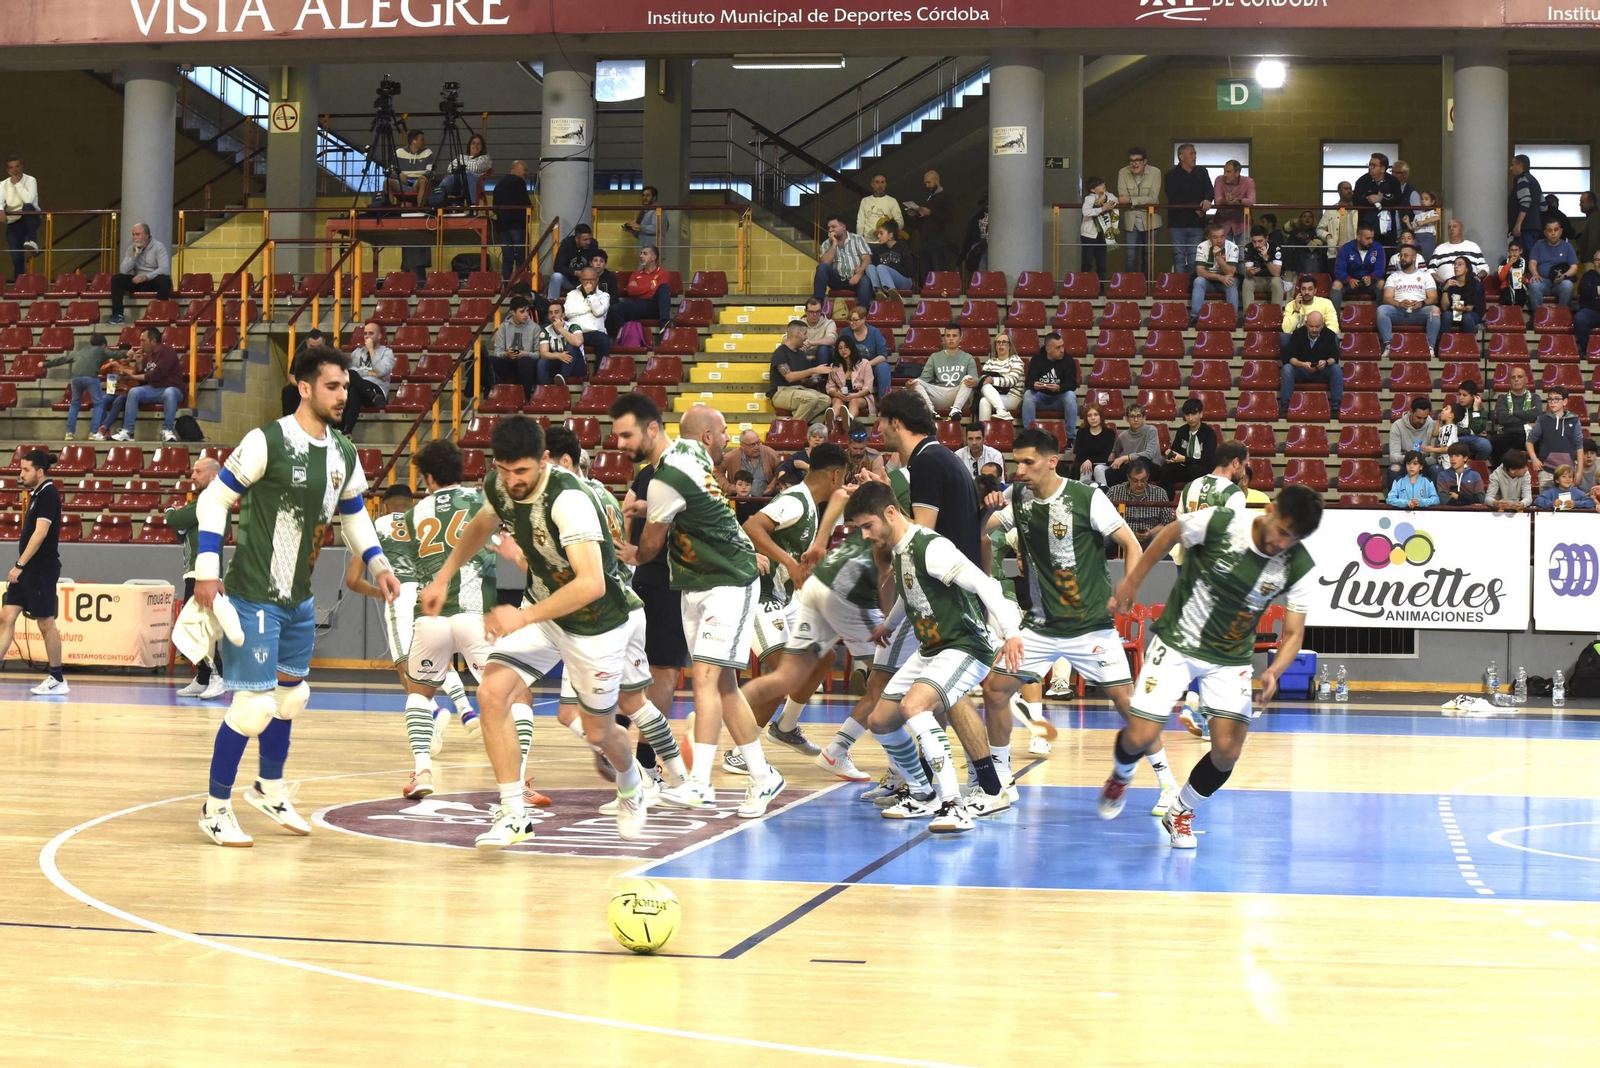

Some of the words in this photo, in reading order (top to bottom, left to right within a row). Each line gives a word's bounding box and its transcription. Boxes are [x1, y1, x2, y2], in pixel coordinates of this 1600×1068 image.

[130, 0, 276, 36] VISTA
[292, 0, 510, 31] ALEGRE
[647, 10, 716, 25] Instituto
[720, 8, 802, 27] Municipal
[807, 8, 829, 23] de
[834, 8, 912, 26] Deportes
[916, 6, 990, 21] Córdoba
[1547, 6, 1600, 21] Institu
[1230, 83, 1249, 105] D
[1319, 561, 1507, 618] Lunettes
[256, 609, 265, 634] 1
[1385, 610, 1484, 622] ANIMACIONES
[67, 653, 136, 662] #ESTAMOSCONTIGO
[1152, 645, 1167, 666] 3
